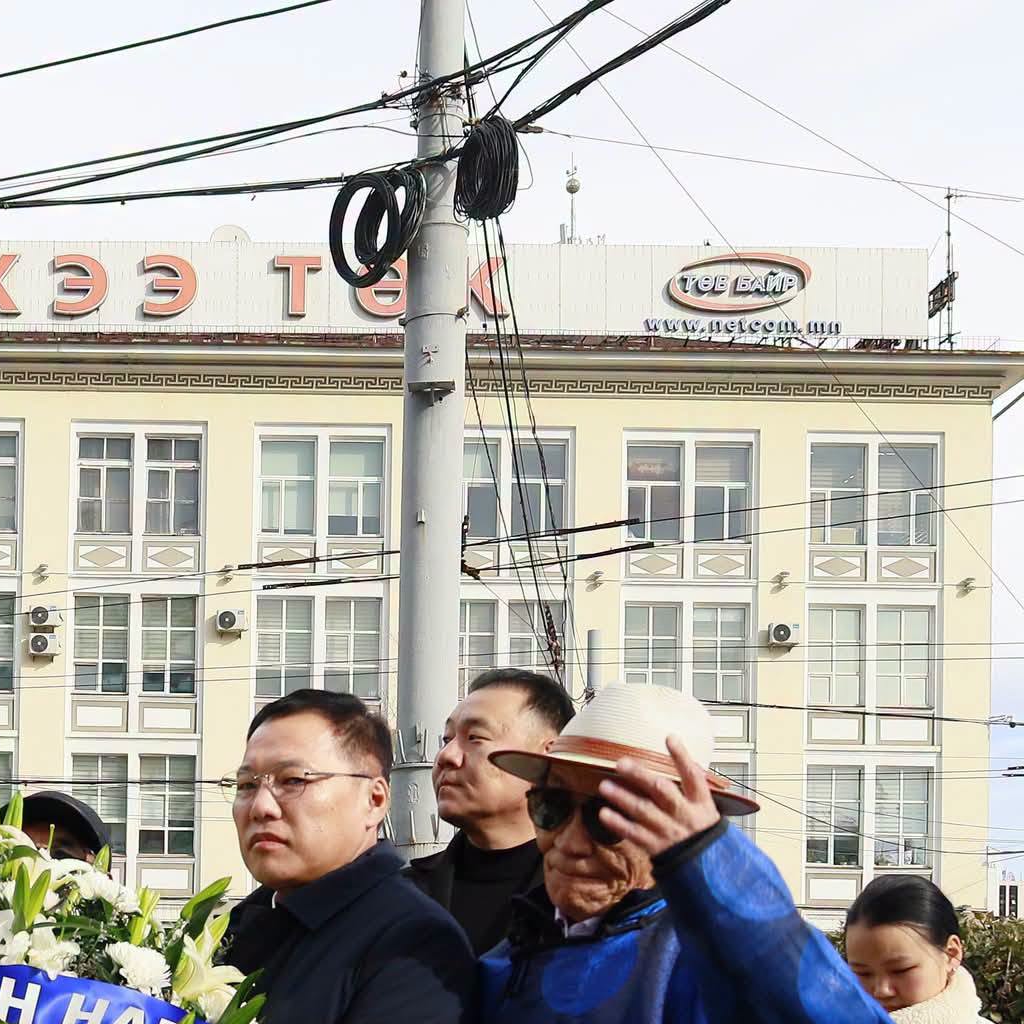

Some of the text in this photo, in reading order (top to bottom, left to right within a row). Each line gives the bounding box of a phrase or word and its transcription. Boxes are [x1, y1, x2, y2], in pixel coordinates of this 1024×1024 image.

[682, 268, 798, 293] ТӨВ БАЙР
[644, 317, 842, 335] www.netcom.mn
